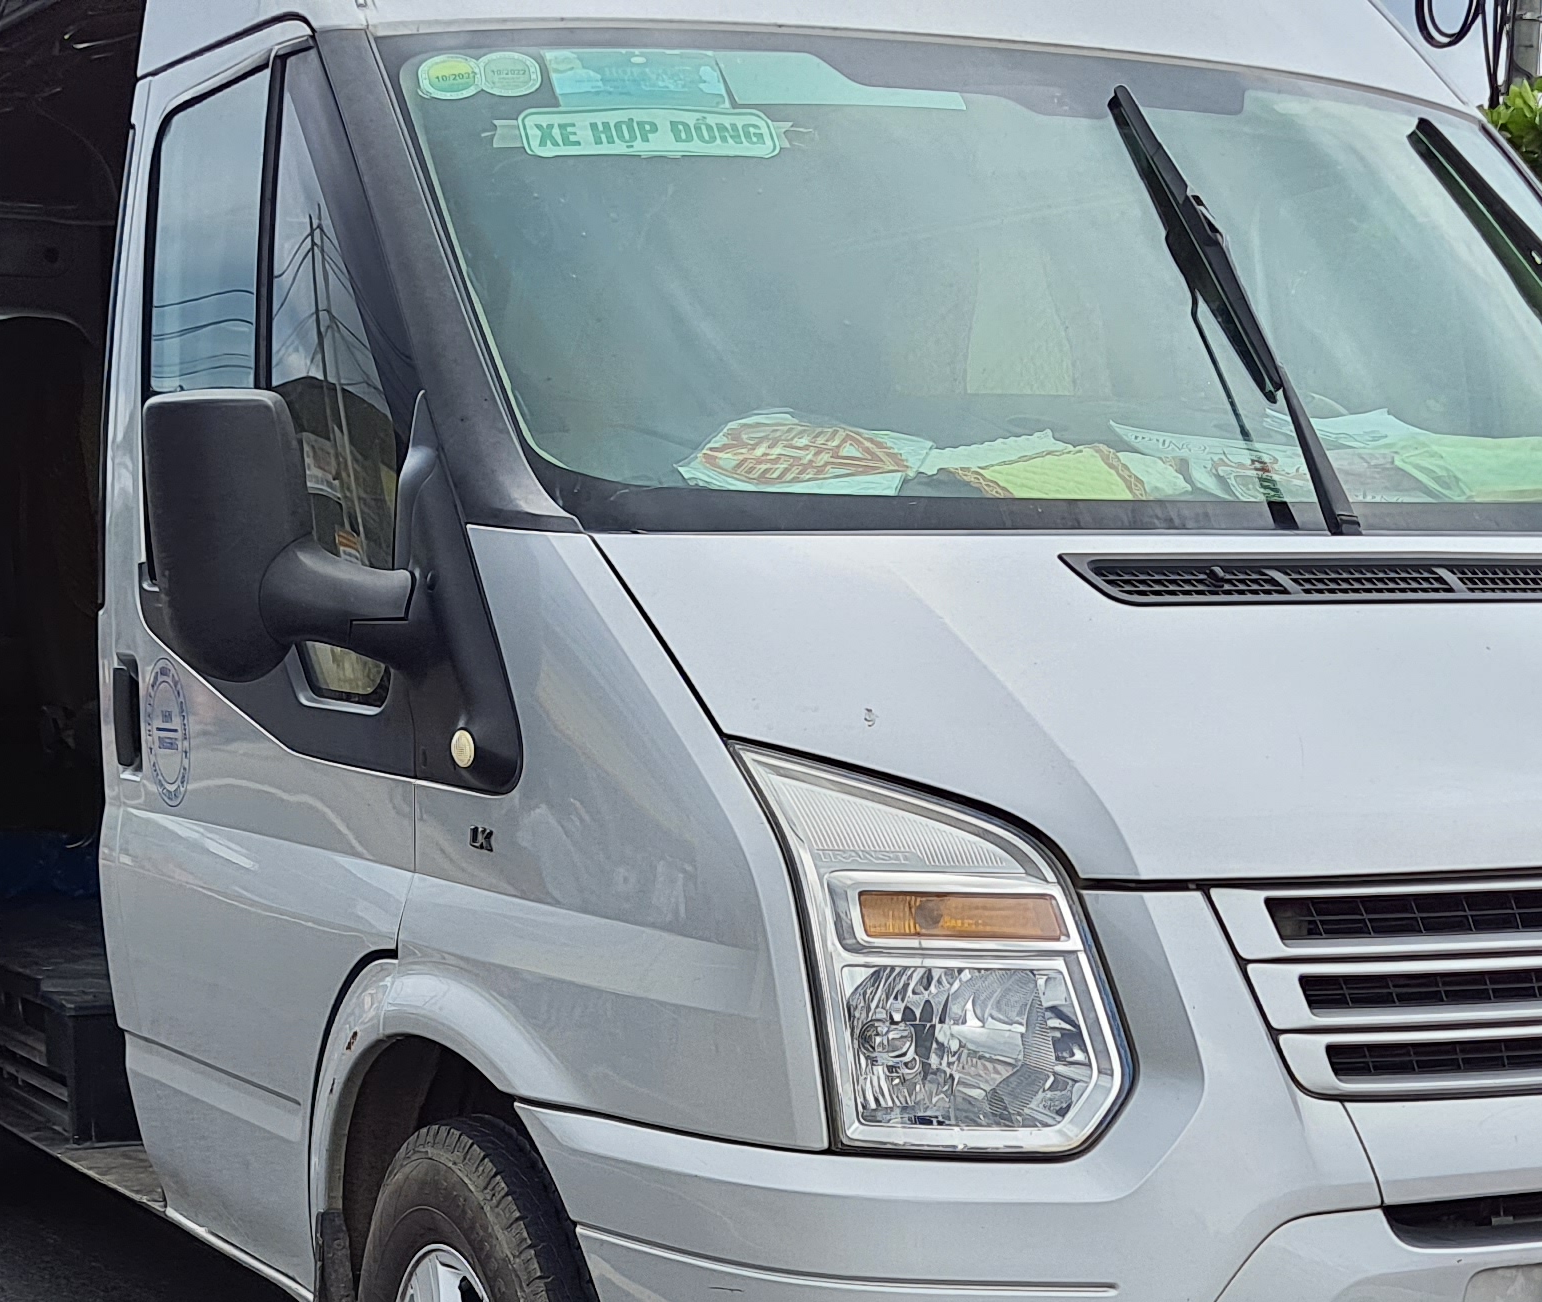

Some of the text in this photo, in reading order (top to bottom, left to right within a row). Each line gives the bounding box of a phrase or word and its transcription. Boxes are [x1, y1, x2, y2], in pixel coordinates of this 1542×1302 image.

[534, 115, 766, 150] XE HỢP ĐỒNG
[816, 850, 911, 864] TRANSIT
